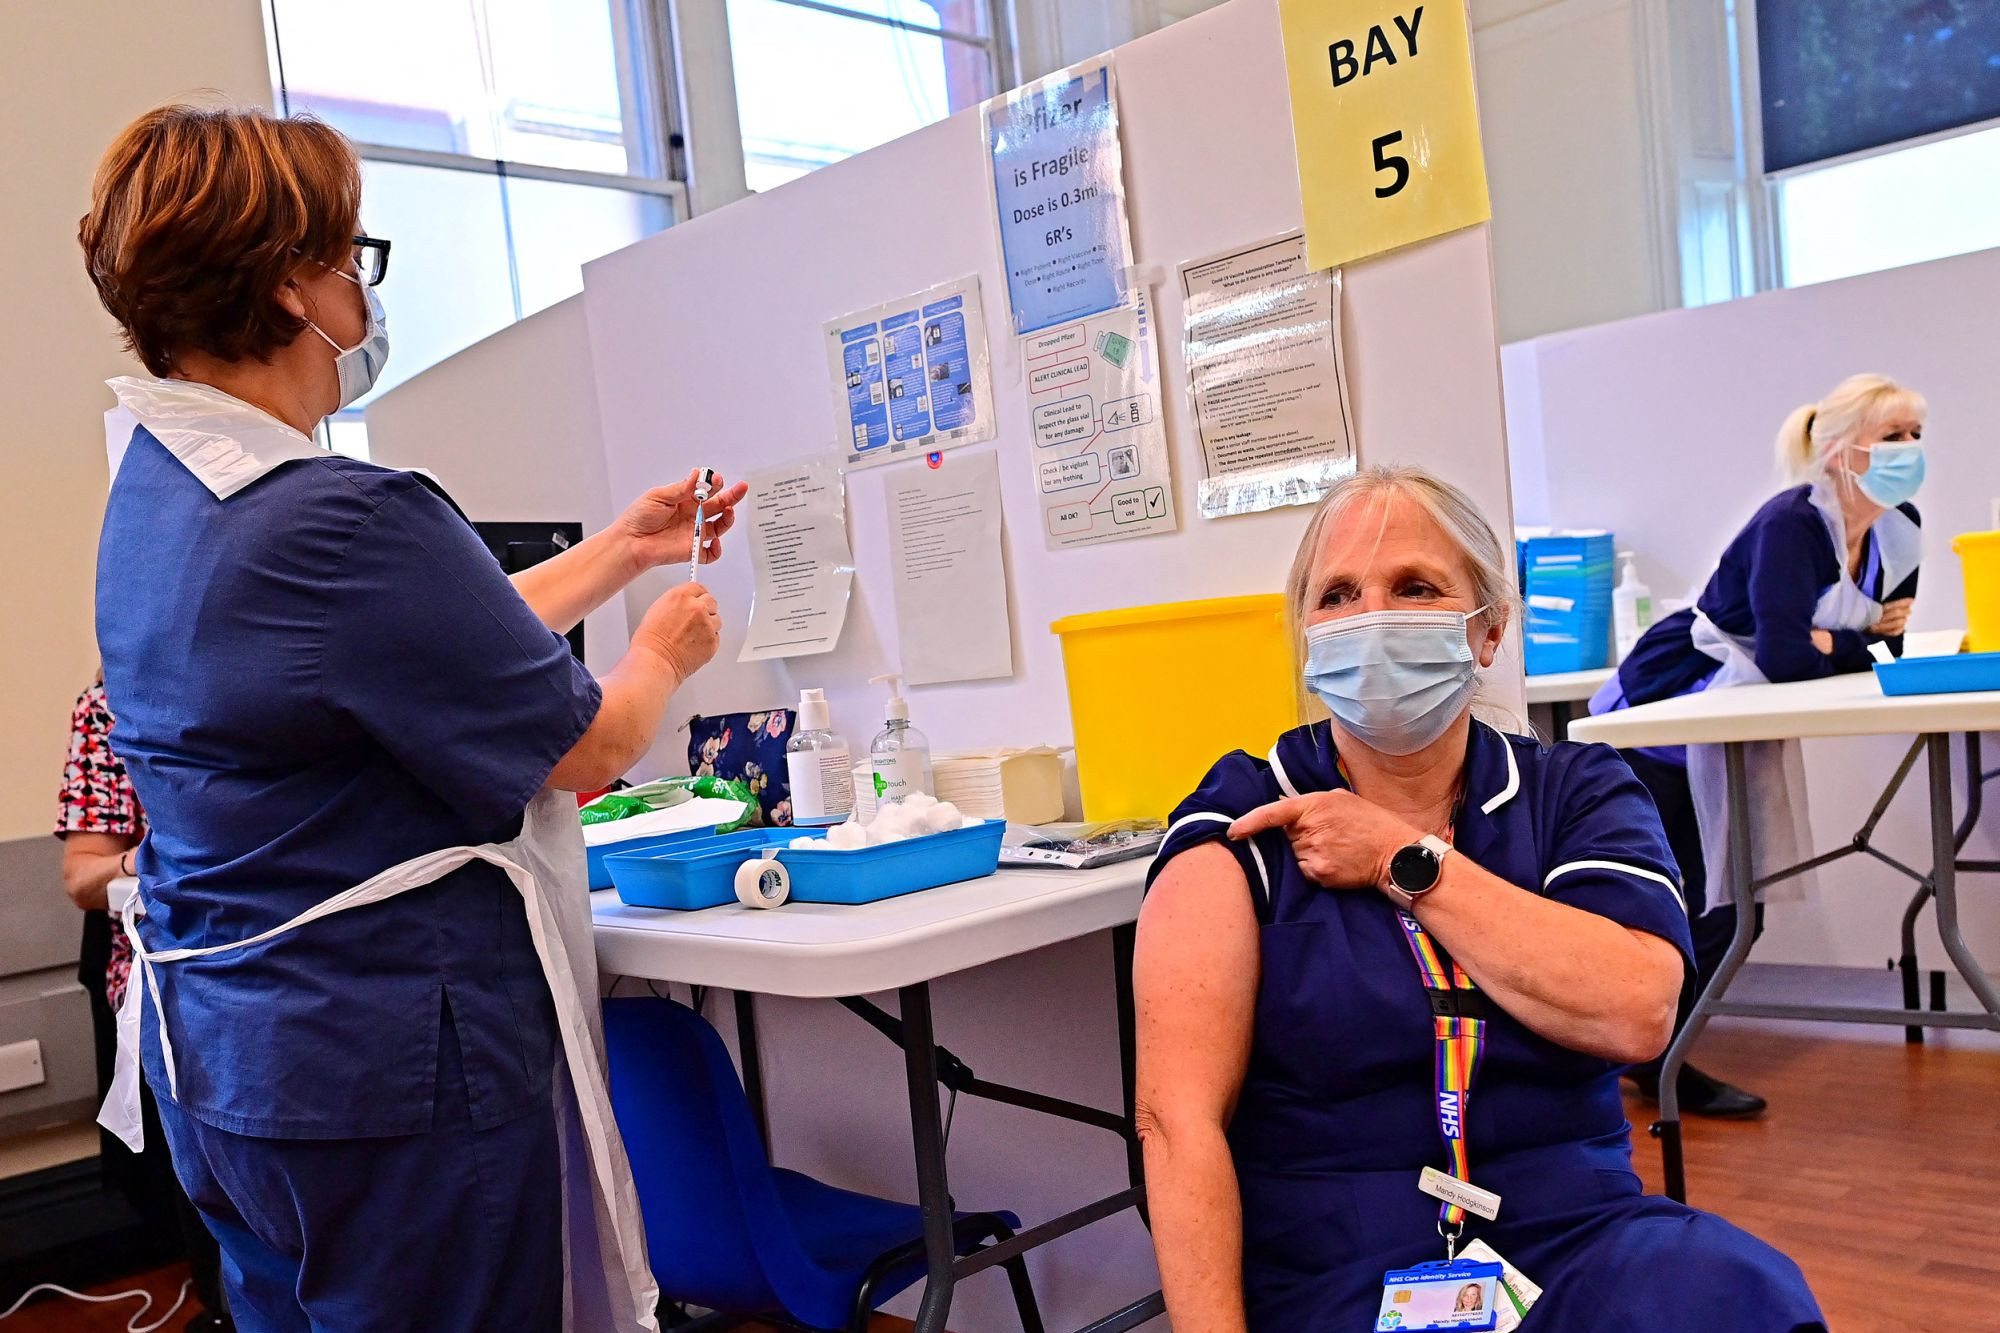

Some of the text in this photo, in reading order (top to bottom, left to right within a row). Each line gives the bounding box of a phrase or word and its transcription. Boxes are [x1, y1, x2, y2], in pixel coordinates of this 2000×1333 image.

[1329, 6, 1424, 87] BAY
[1014, 146, 1088, 187] is Fragile
[1372, 130, 1410, 199] 5
[1013, 204, 1045, 224] Dose
[1048, 197, 1058, 212] is
[1045, 226, 1073, 248] 6R's
[1229, 271, 1244, 279] Vaccine
[1245, 262, 1275, 275] Administration
[1275, 256, 1297, 267] Technique
[1066, 278, 1086, 288] Records
[1038, 333, 1076, 348] Dropped Pfizer
[1035, 363, 1088, 382] ALERT CLINICAL LEAD
[1044, 408, 1062, 418] Clinical
[1063, 404, 1075, 413] Lead
[1067, 416, 1080, 425] glass
[1080, 412, 1090, 420] vial
[1064, 427, 1085, 436] damage
[1217, 450, 1237, 458] Document
[1254, 451, 1273, 459] repeated
[1043, 466, 1058, 475] Check
[1070, 460, 1089, 470] vigilant
[1053, 477, 1062, 485] any
[1063, 473, 1084, 482] frothing
[1118, 498, 1132, 506] Good
[1068, 511, 1078, 519] OK?
[1440, 1092, 1460, 1139] NHS
[1435, 1184, 1495, 1215] Mandy Hodgkinson
